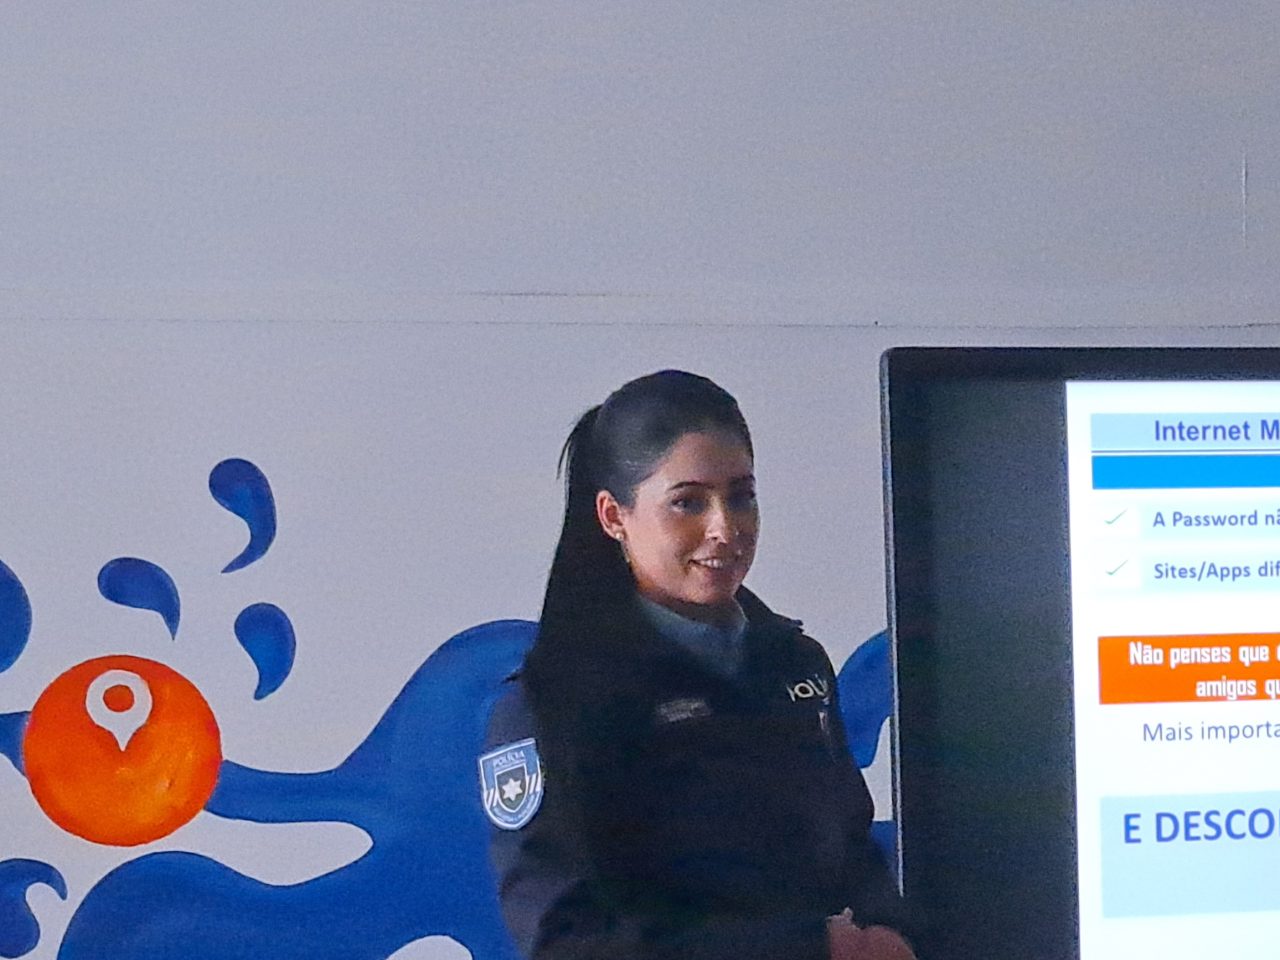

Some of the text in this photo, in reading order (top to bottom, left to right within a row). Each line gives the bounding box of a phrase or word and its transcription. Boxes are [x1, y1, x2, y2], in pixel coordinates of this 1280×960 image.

[1154, 419, 1251, 442] Internet
[1152, 511, 1166, 528] A
[1172, 509, 1258, 527] Password
[1154, 561, 1251, 582] Sites/Apps
[1128, 641, 1164, 666] Não
[1168, 646, 1232, 670] penses
[1238, 645, 1270, 668] que
[1195, 675, 1259, 702] amigos
[1142, 722, 1193, 742] Mais
[1123, 813, 1142, 844] E
